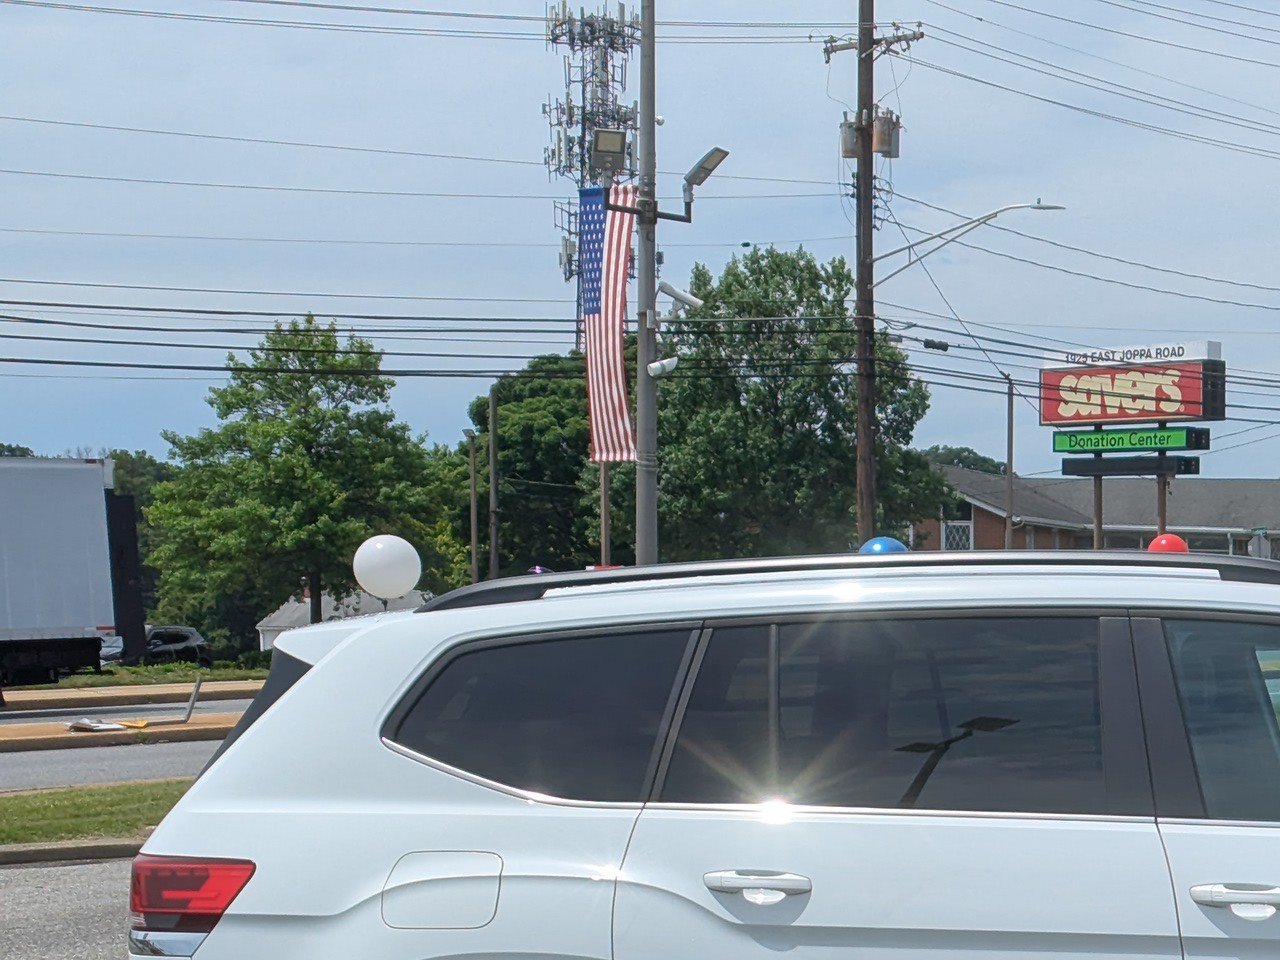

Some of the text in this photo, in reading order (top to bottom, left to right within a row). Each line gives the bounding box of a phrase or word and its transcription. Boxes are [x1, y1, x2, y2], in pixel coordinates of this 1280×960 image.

[1091, 351, 1117, 362] EAST
[1120, 348, 1152, 361] JOPPA
[1155, 346, 1185, 359] ROAD
[1068, 432, 1172, 449] Donation Center
